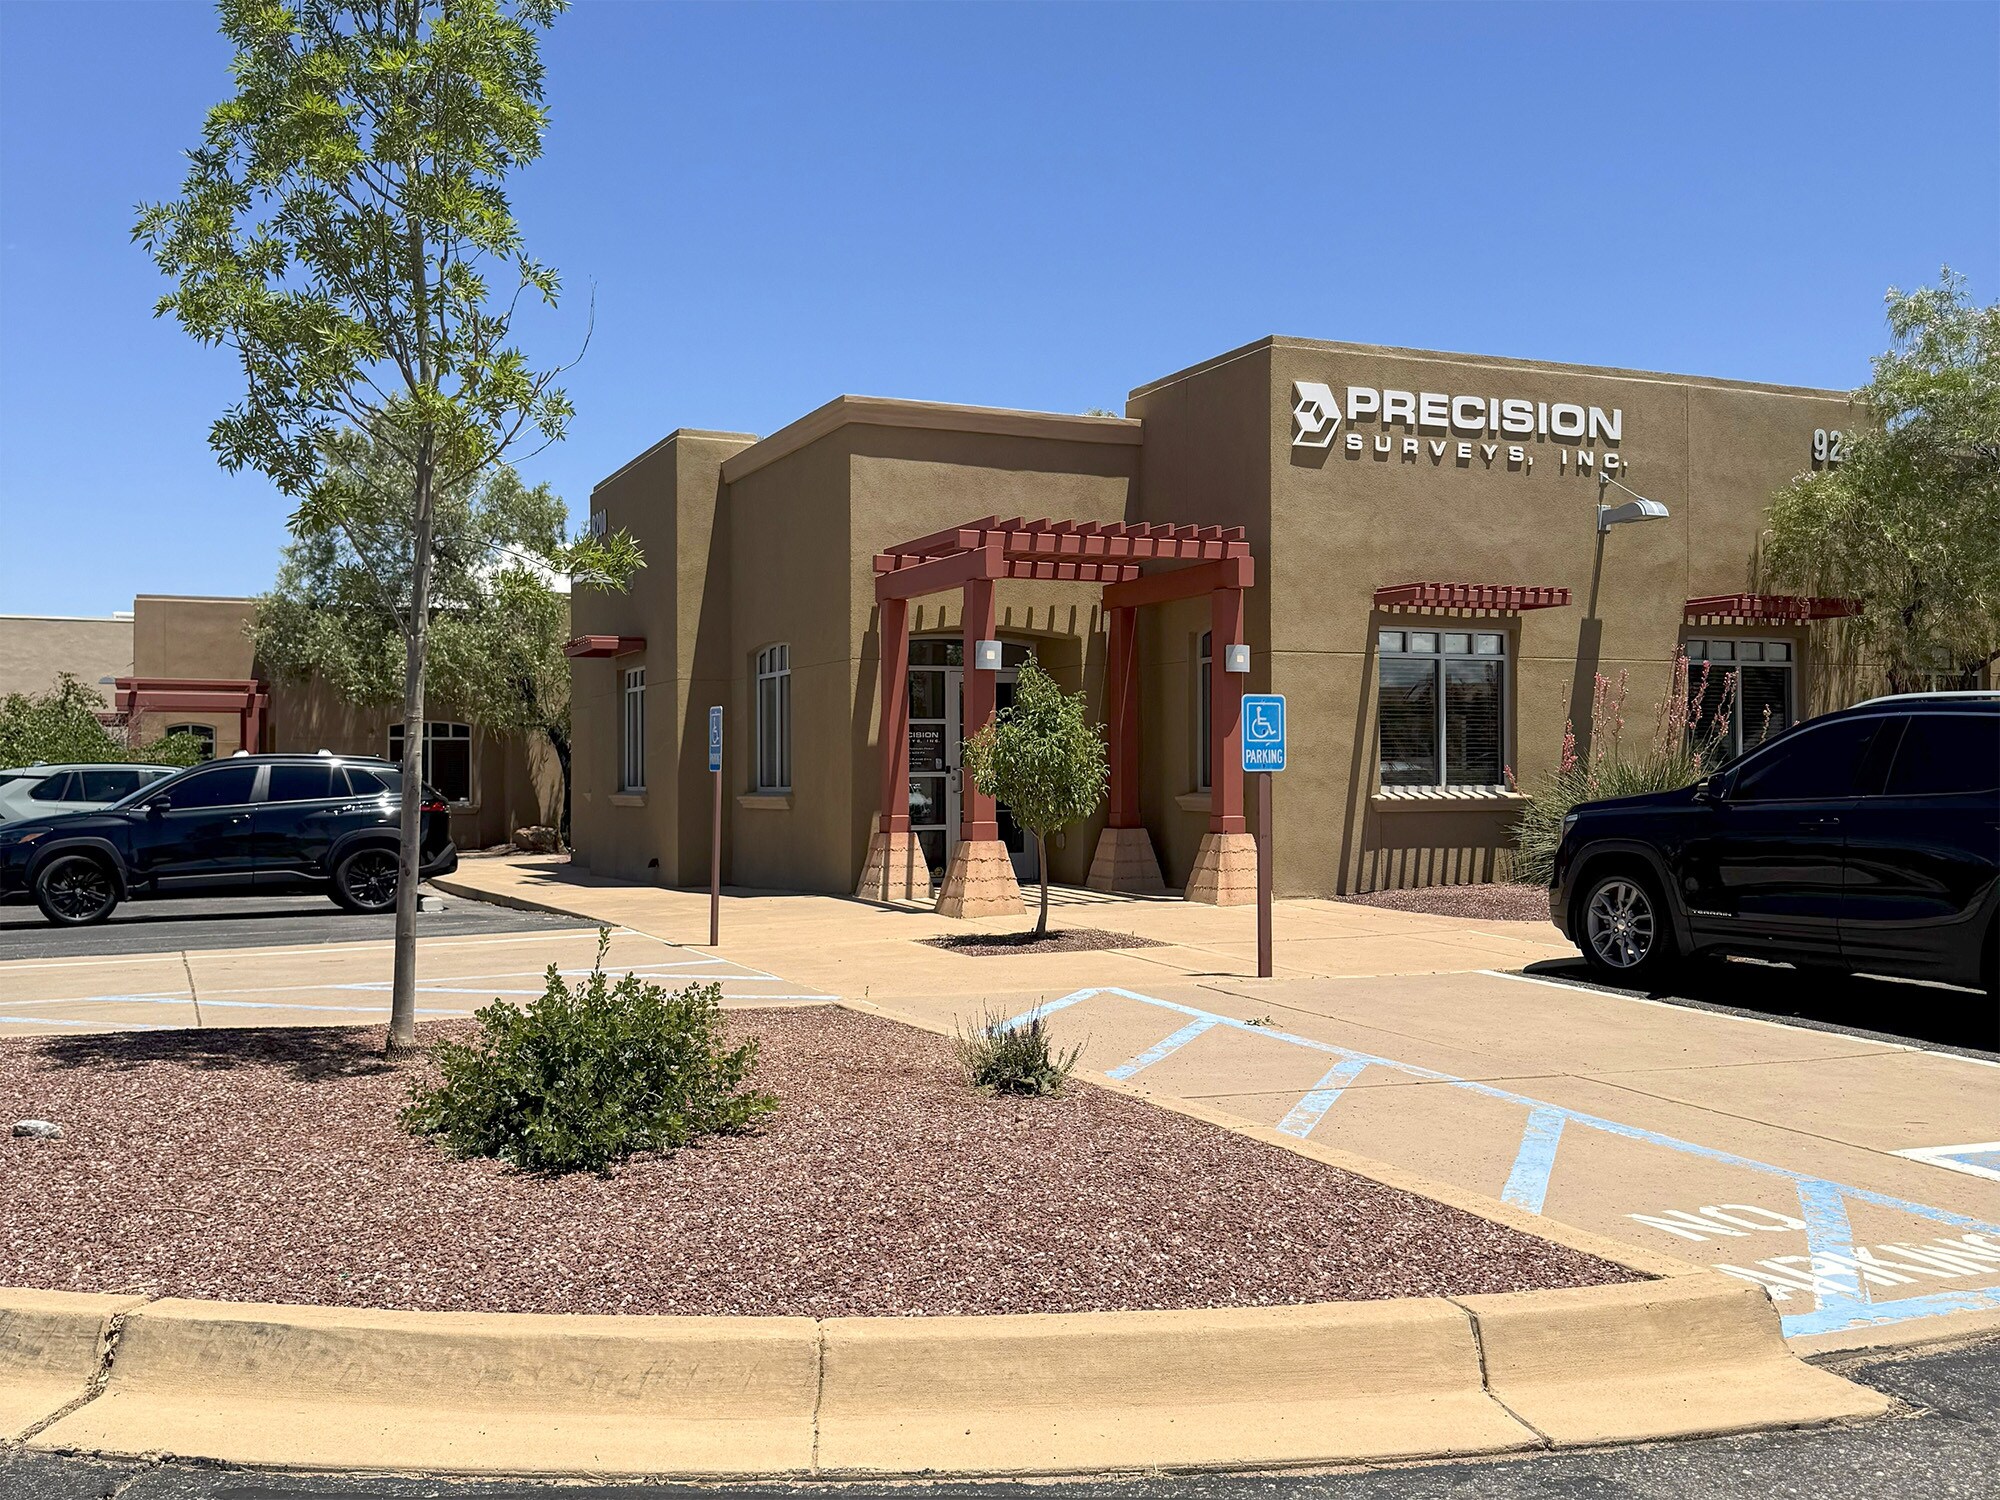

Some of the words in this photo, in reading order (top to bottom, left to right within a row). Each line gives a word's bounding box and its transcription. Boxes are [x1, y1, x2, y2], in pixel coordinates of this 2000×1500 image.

[1346, 386, 1622, 441] PRECISION
[1346, 433, 1535, 466] SURVEYS,
[1562, 449, 1628, 468] INC.
[1814, 428, 1844, 462] 92
[1245, 749, 1283, 764] PARKING
[1692, 909, 1732, 917] TERRAIN
[1623, 1203, 1807, 1242] NO
[1711, 1232, 2000, 1301] ARKIN
